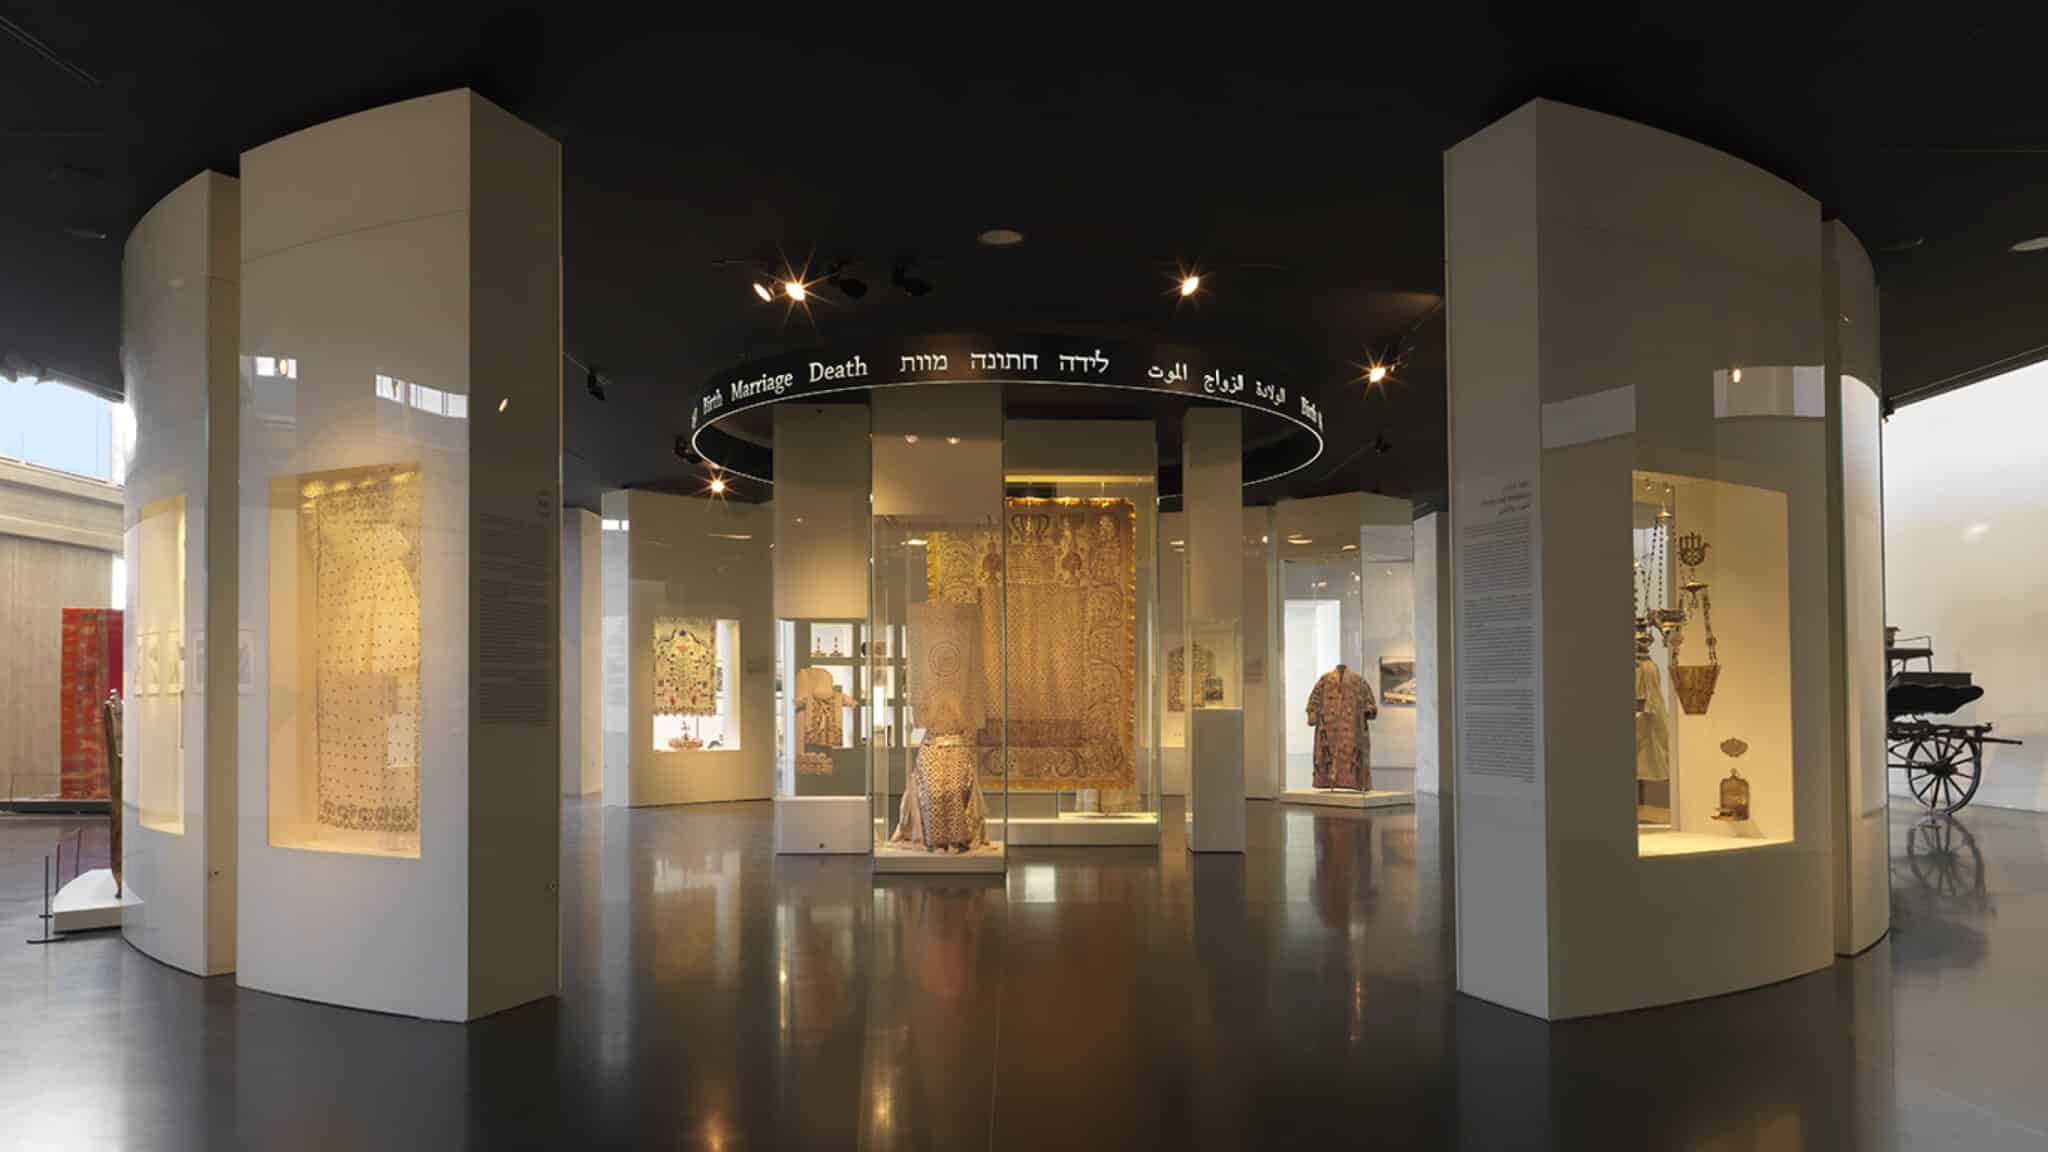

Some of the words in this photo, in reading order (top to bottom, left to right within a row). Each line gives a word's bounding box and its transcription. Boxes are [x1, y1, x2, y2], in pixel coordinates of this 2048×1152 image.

[900, 353, 948, 372] מוות
[971, 352, 1038, 371] חתונה
[1059, 350, 1109, 373] לידה
[731, 373, 793, 401] Marriage
[808, 355, 868, 382] Death
[1148, 362, 1188, 384] الموت
[1203, 369, 1243, 394] الزواج
